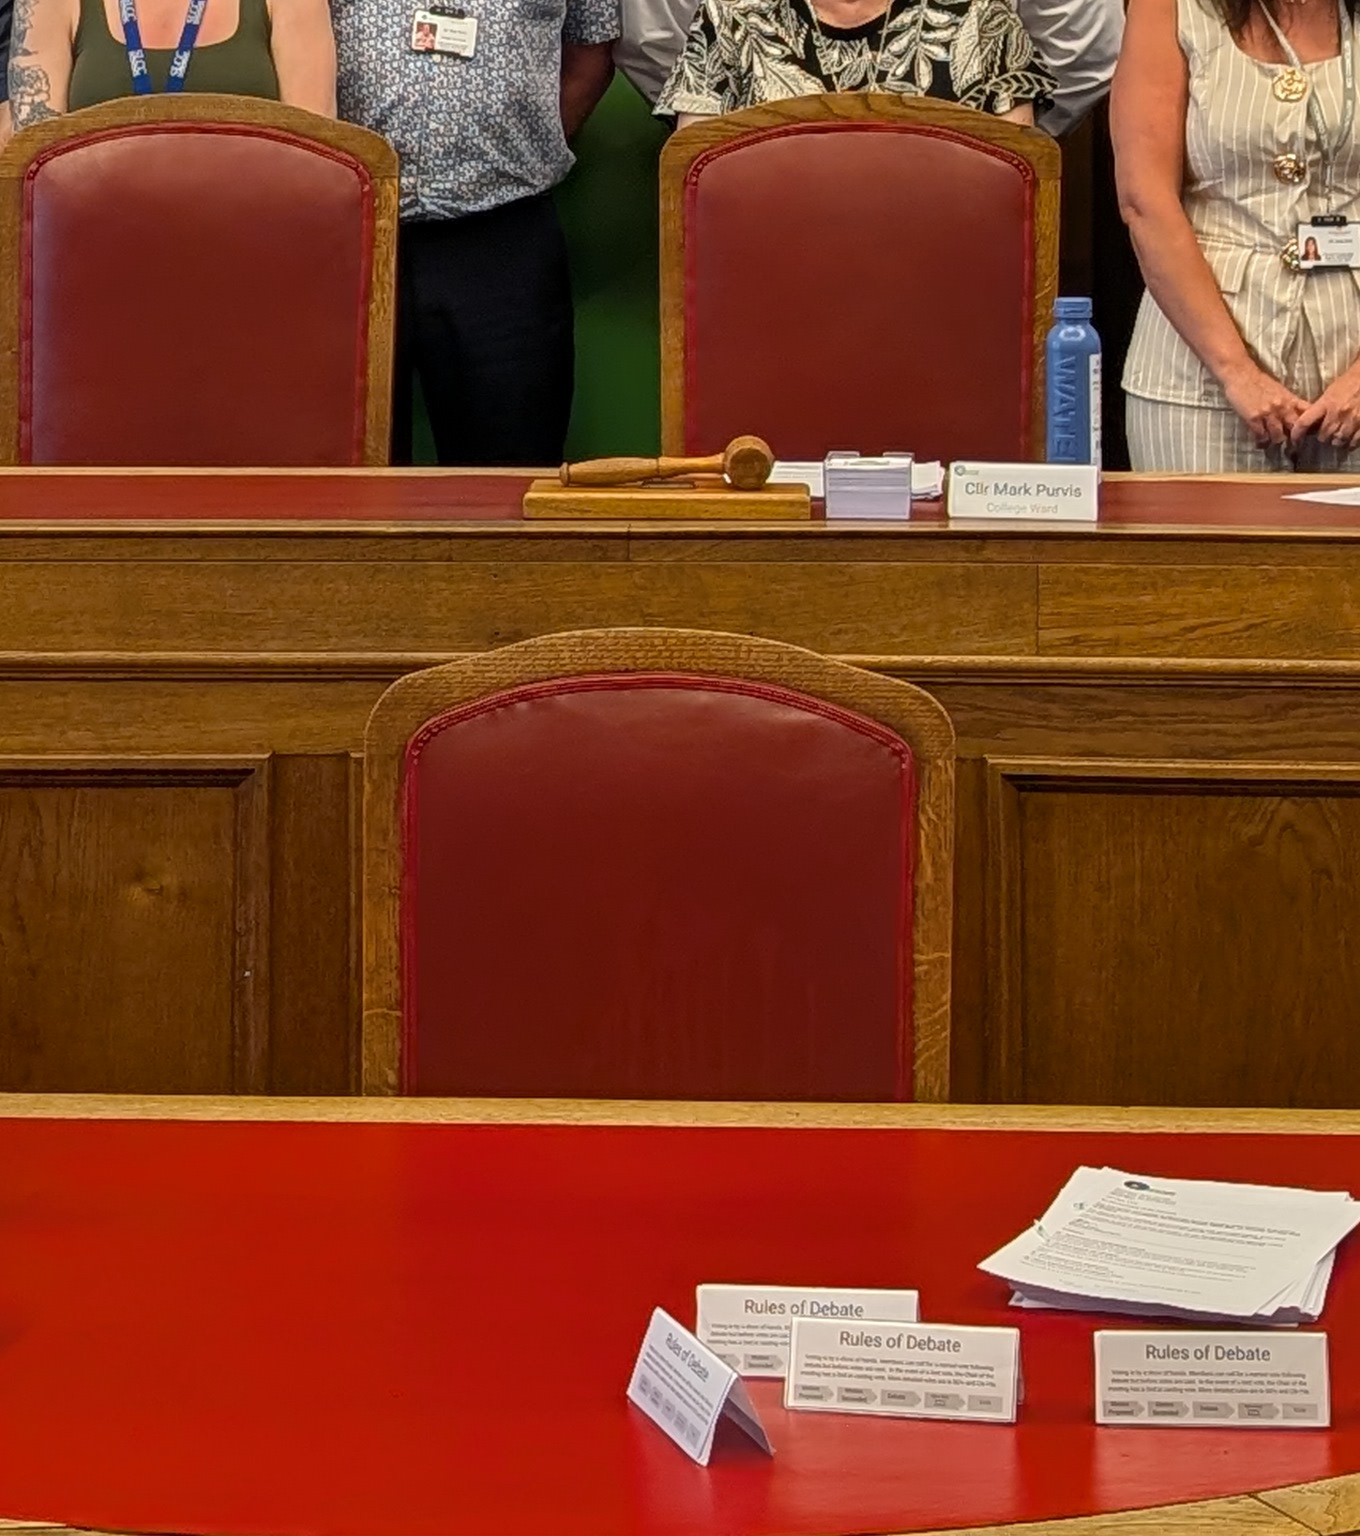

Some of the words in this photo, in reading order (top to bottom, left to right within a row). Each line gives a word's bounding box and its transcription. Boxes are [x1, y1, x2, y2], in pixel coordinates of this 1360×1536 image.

[993, 482, 1033, 497] Mark
[1036, 483, 1082, 498] Purvis
[745, 1299, 786, 1315] Rules
[790, 1299, 808, 1315] of
[809, 1300, 864, 1318] Debate
[839, 1330, 882, 1348] Rules
[886, 1333, 905, 1349] of
[906, 1334, 962, 1353] Debate
[1145, 1344, 1190, 1361] Rules
[1193, 1344, 1211, 1361] of
[1214, 1345, 1271, 1362] Debate
